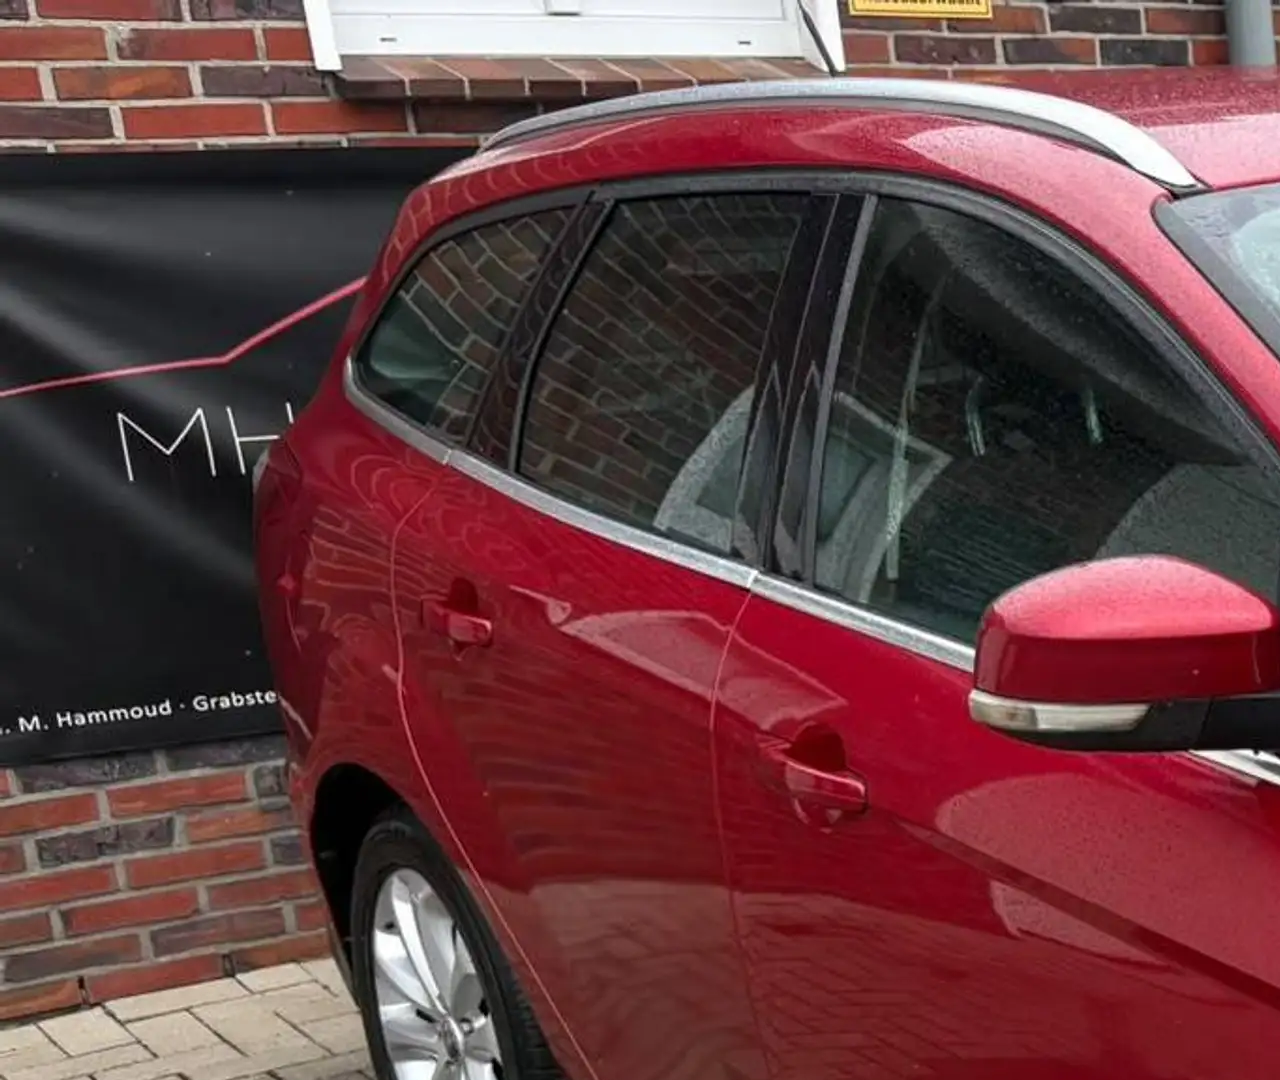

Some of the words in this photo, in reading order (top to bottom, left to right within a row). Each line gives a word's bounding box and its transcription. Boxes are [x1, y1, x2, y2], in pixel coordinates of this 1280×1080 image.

[18, 716, 49, 733] M.
[56, 699, 172, 728] Hammoud
[192, 689, 281, 712] Grabste
